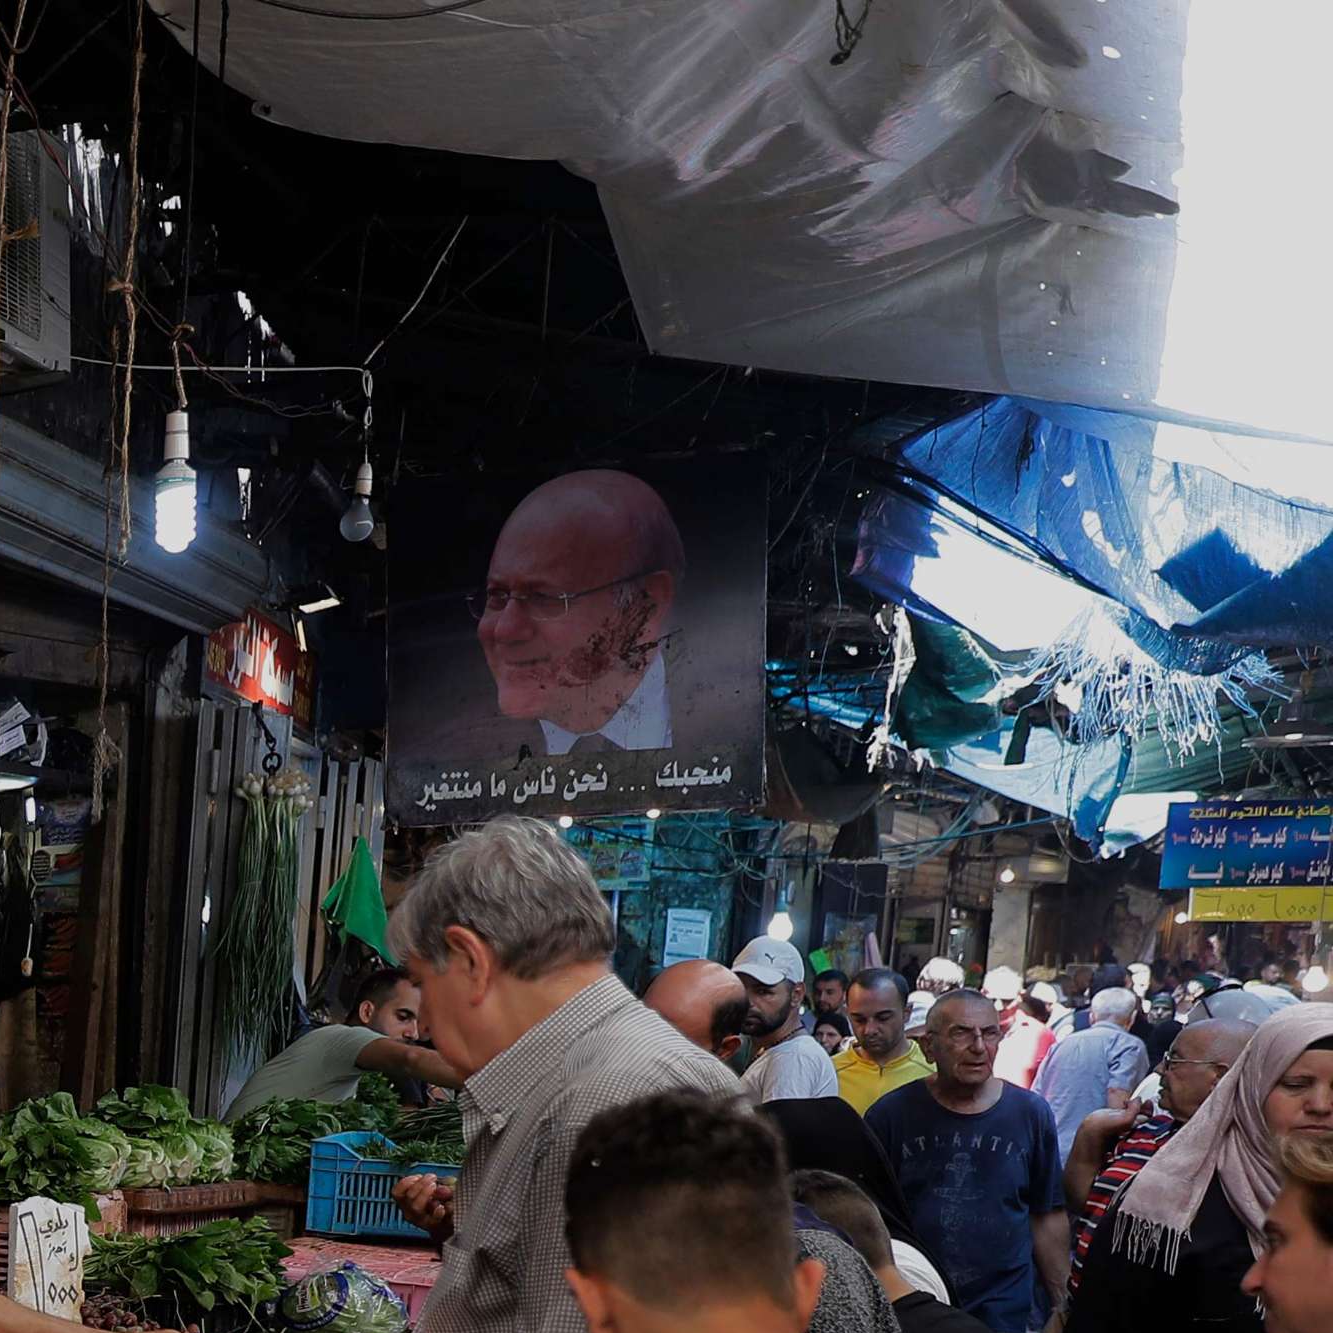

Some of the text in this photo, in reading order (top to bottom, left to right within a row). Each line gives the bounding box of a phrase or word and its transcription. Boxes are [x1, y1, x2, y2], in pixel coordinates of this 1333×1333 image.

[490, 772, 507, 799] ما
[512, 767, 557, 804] ناس
[564, 762, 609, 802] نحن
[655, 756, 732, 789] منحبك
[415, 769, 482, 812] منتغير
[39, 1207, 70, 1240] بلدي
